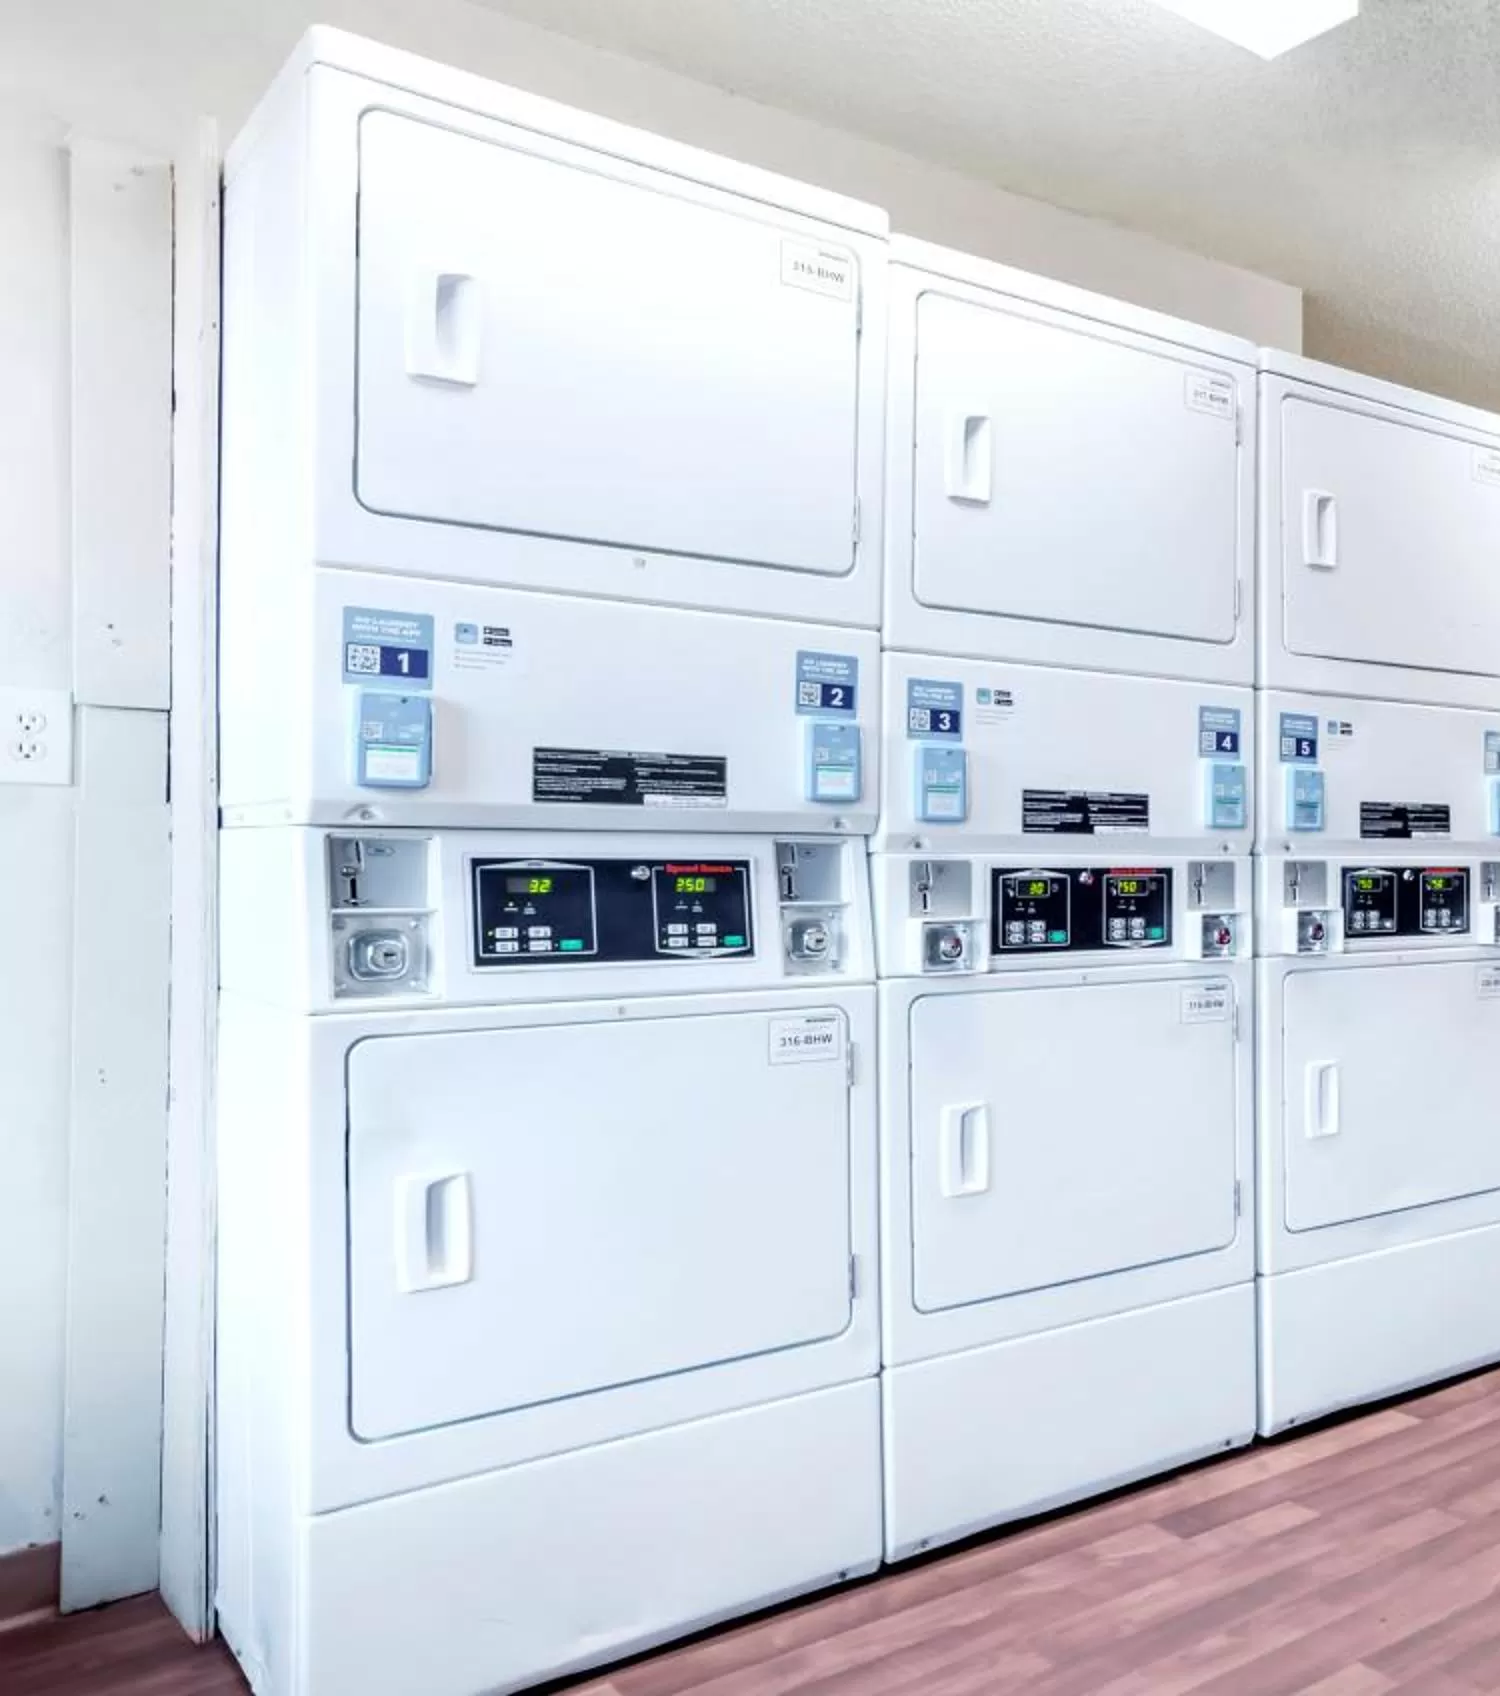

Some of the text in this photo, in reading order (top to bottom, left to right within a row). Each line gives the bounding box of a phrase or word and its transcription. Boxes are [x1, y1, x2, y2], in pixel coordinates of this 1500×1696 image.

[397, 651, 409, 674] 1
[831, 687, 844, 706] 2
[939, 712, 951, 730] 3
[1221, 735, 1232, 751] 4
[1301, 741, 1311, 755] 5
